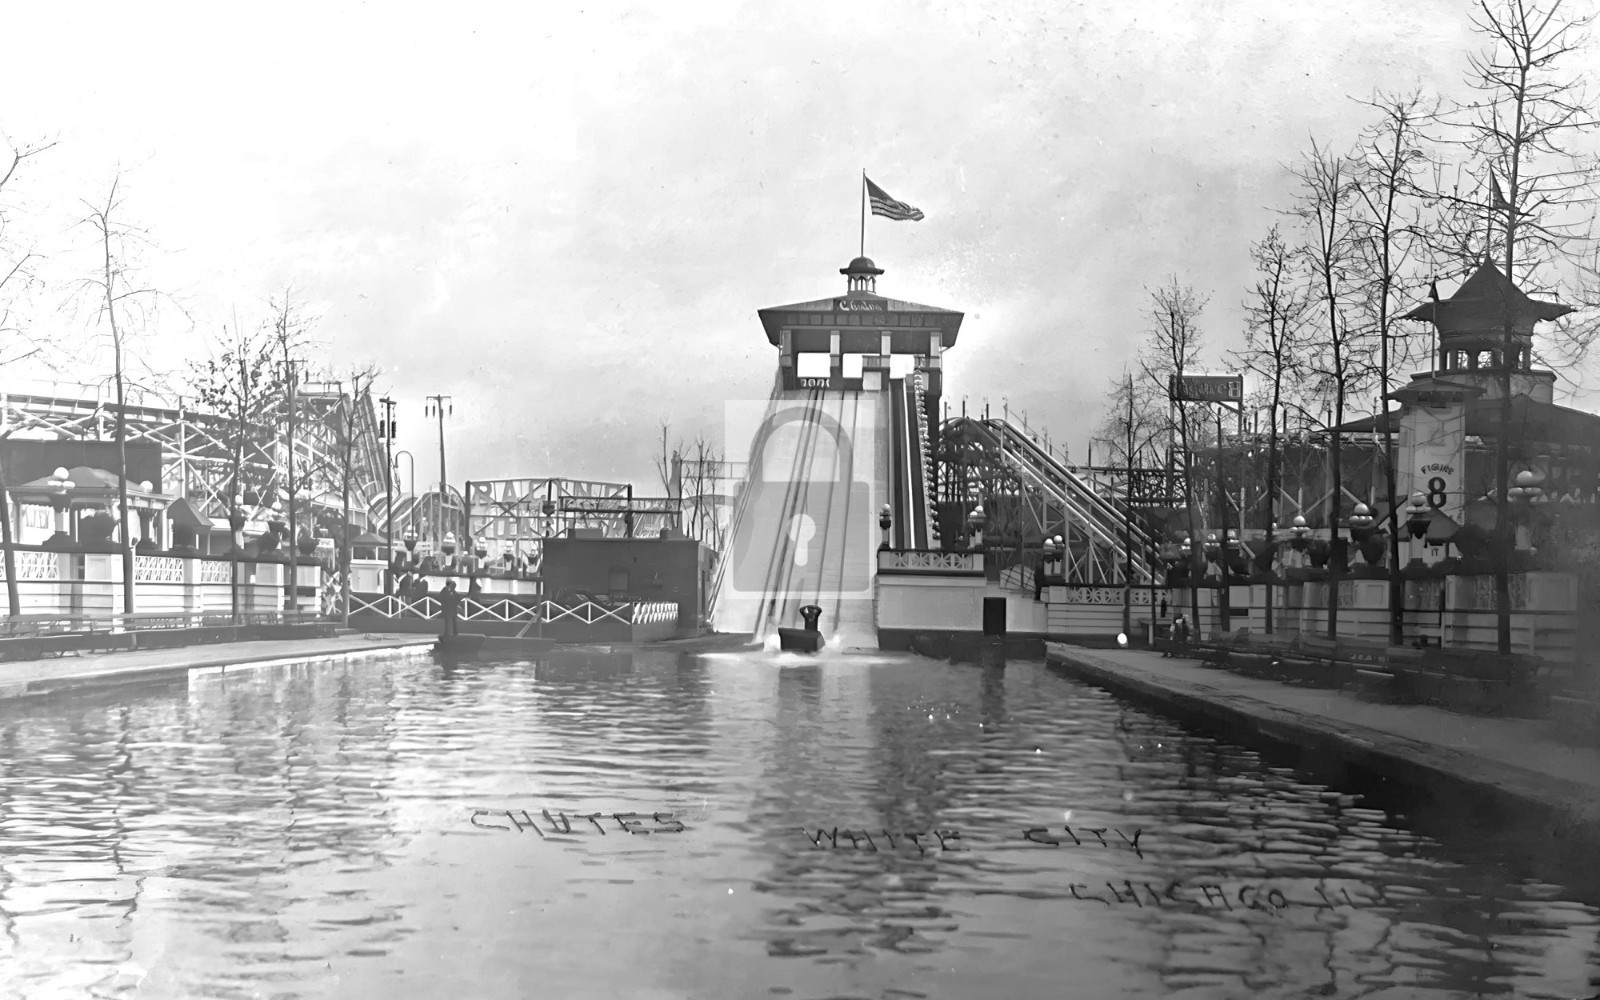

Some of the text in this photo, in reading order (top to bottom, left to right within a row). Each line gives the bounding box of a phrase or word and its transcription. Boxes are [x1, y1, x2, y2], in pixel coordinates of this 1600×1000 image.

[1426, 476, 1447, 508] 8
[470, 808, 685, 837] CHUTES
[801, 825, 1144, 859] WHITE CITY
[1069, 880, 1289, 914] CHICAGO
